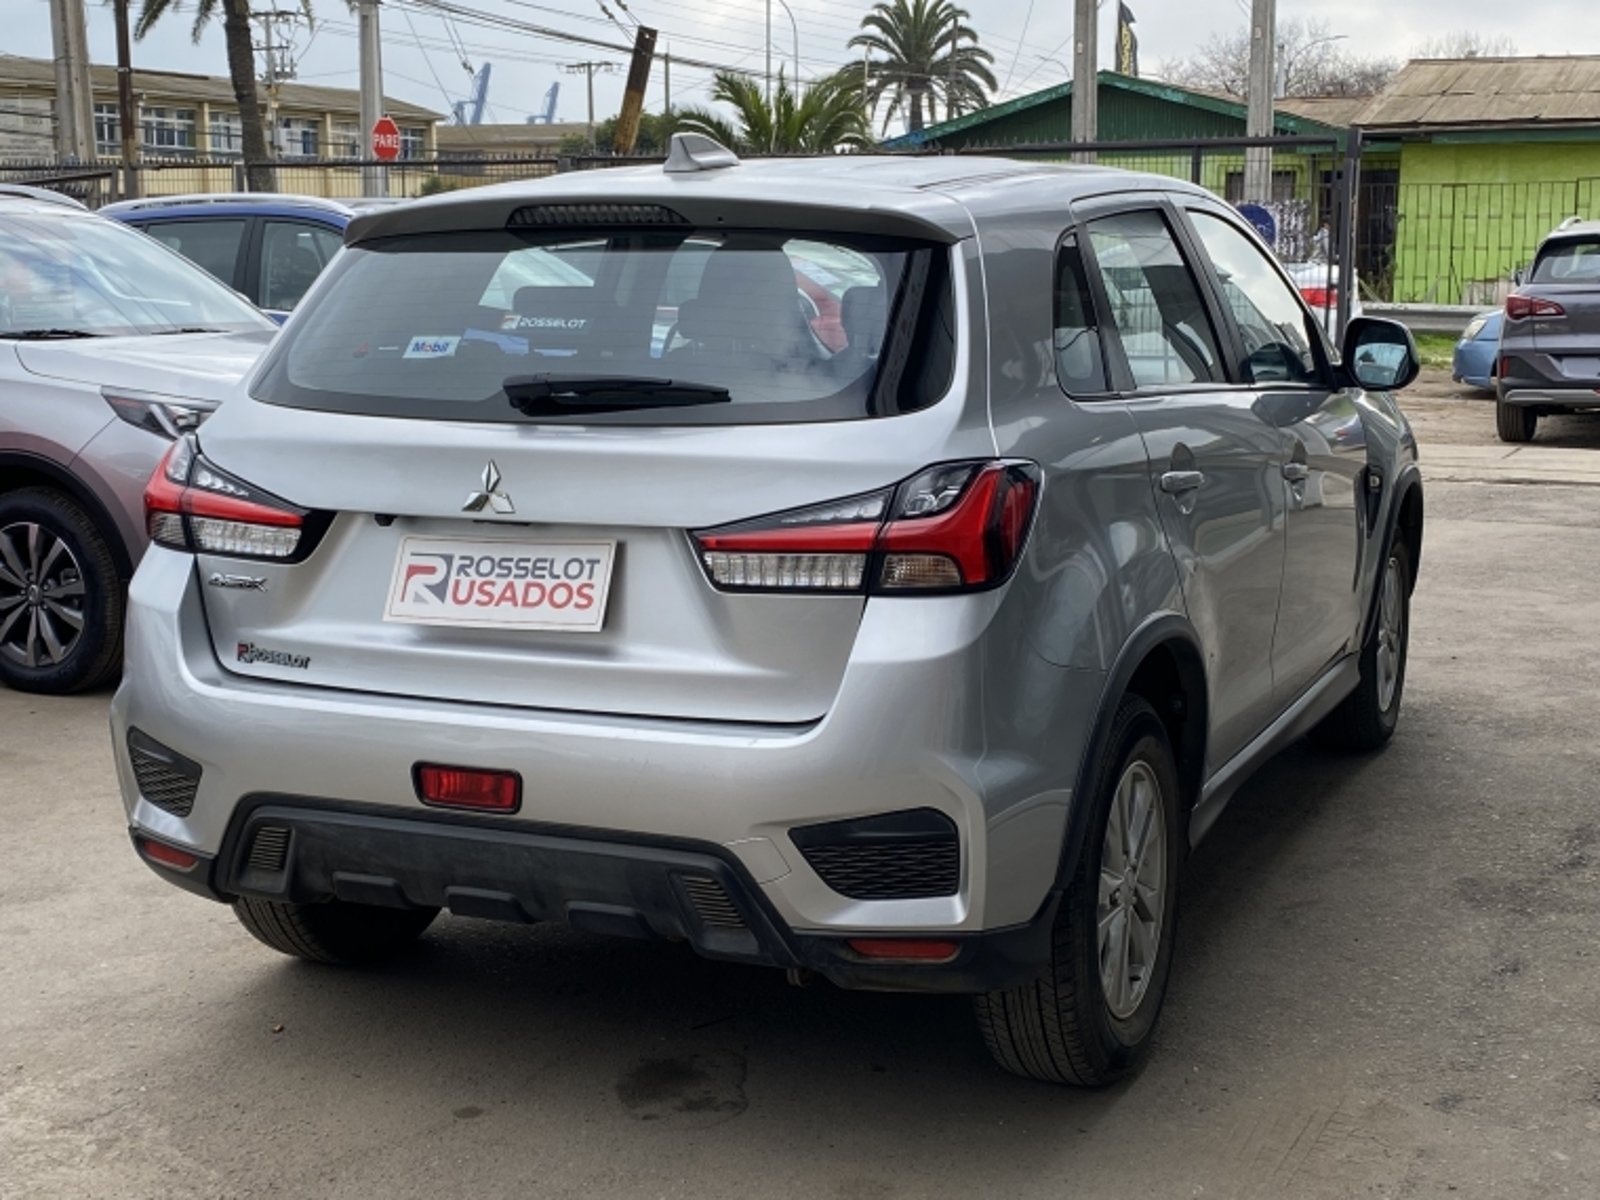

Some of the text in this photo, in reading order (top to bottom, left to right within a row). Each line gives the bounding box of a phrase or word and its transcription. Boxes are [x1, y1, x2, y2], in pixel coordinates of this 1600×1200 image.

[374, 134, 399, 149] PARE
[519, 316, 587, 329] ROSSELOT
[411, 341, 450, 353] Mobil
[456, 555, 601, 580] ROSSELOT
[452, 580, 595, 610] USADOS
